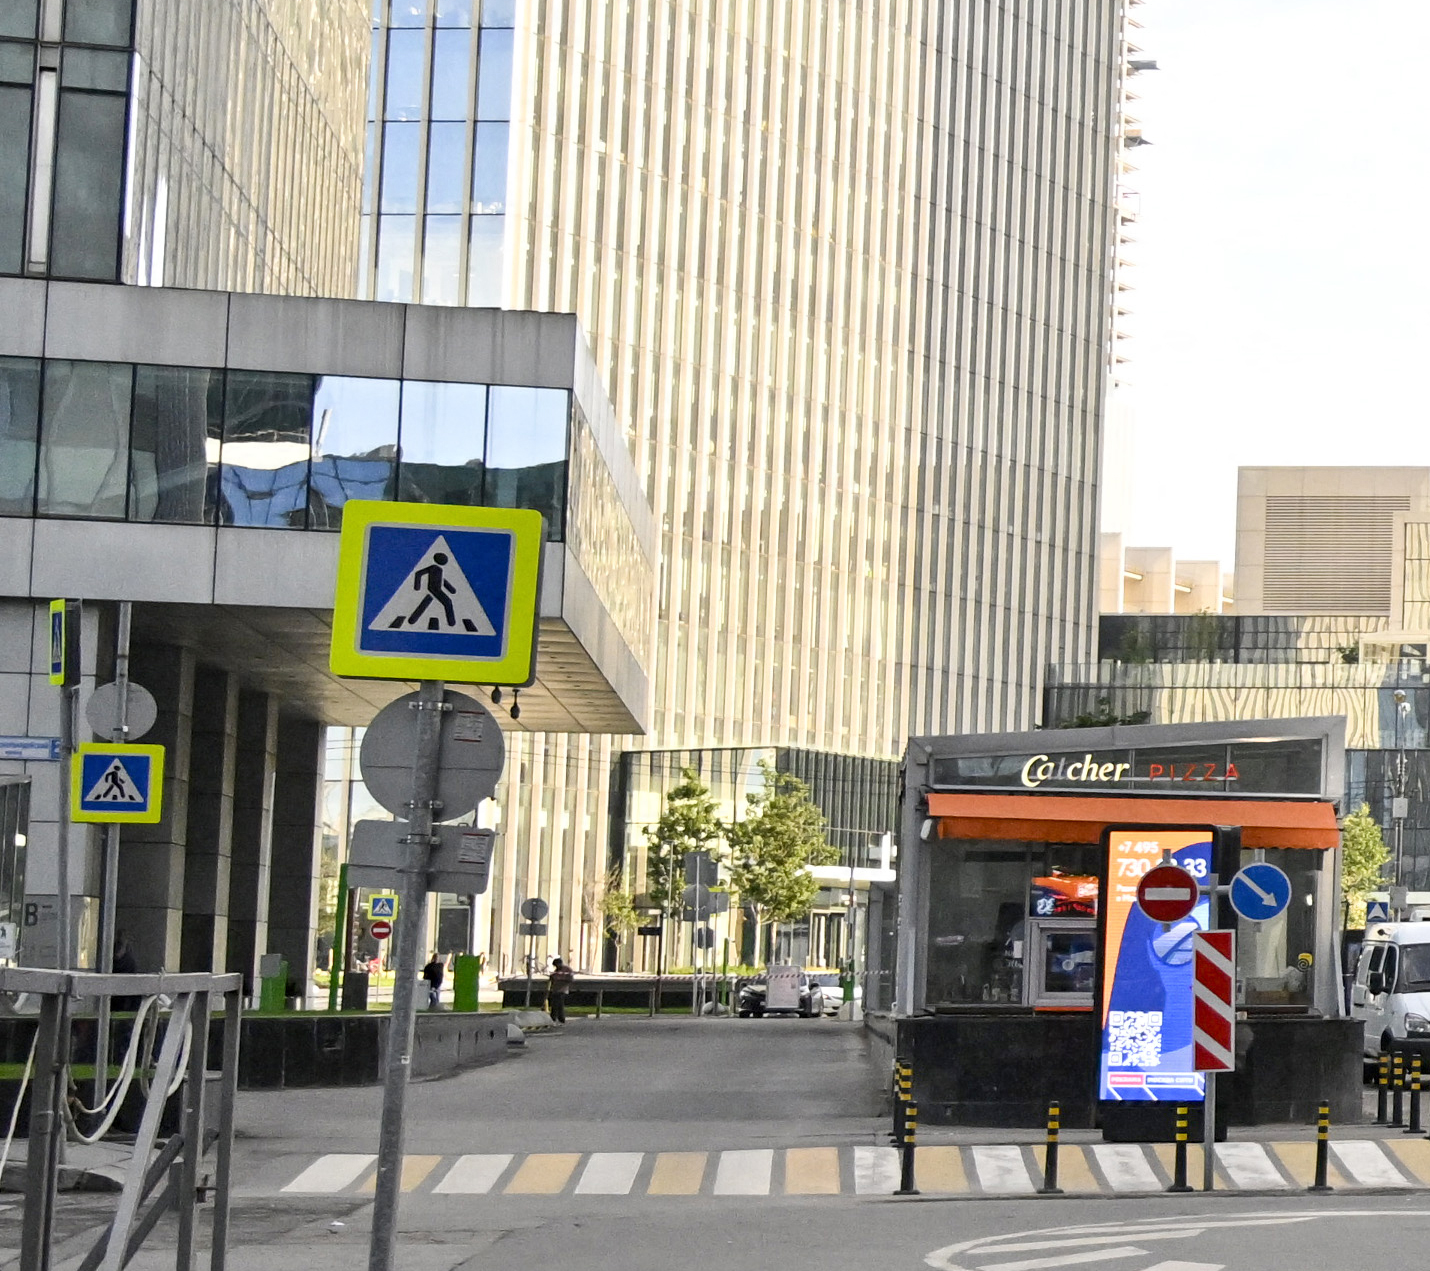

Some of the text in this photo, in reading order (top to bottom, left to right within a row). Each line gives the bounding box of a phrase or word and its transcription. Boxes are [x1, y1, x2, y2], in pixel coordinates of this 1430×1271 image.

[1150, 763, 1240, 781] PIZZA
[1133, 841, 1159, 853] 495
[1117, 858, 1207, 877] 73033
